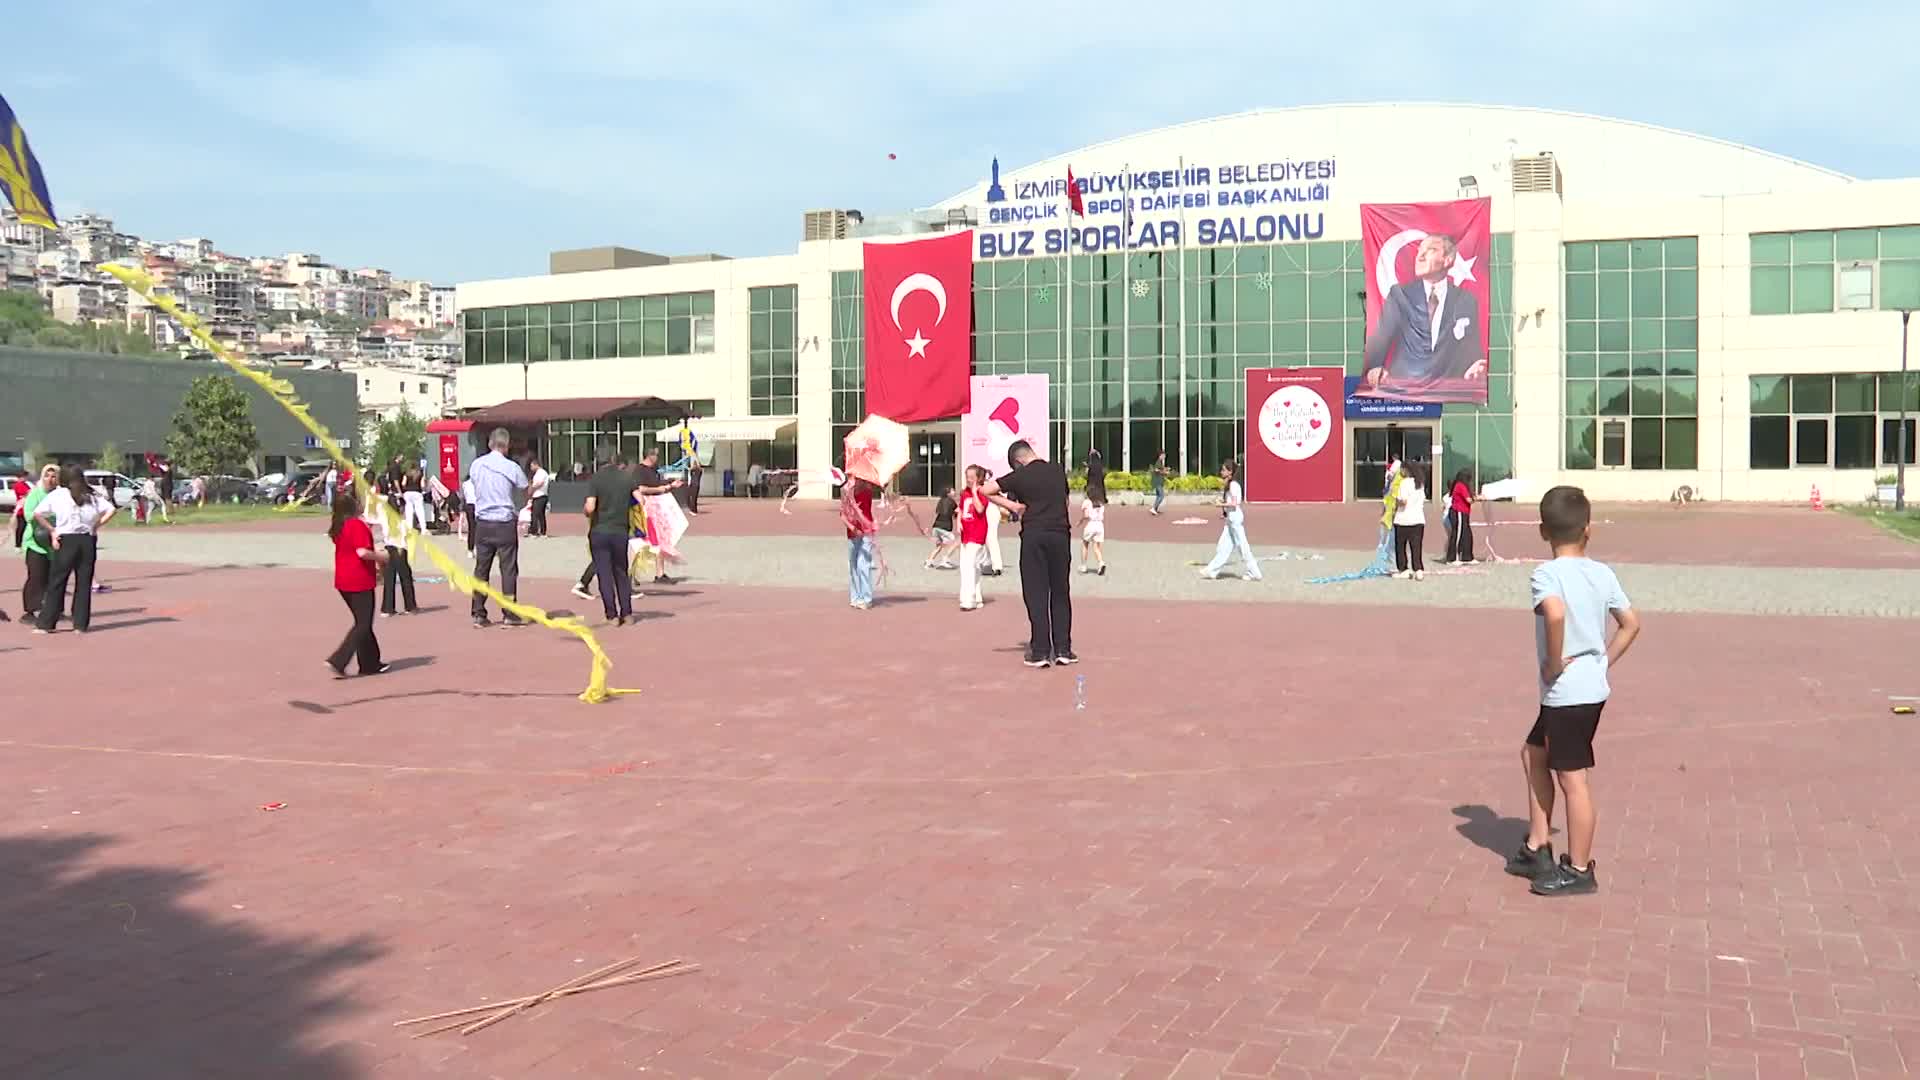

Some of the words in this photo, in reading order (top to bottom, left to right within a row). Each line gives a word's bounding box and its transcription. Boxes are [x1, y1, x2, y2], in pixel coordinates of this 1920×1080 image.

[1014, 176, 1068, 200] İZMİR
[1074, 163, 1210, 197] BÜYÜKŞEHİR
[1218, 156, 1336, 185] BELEDİYESİ
[989, 201, 1059, 225] GENÇLİK
[1217, 182, 1330, 208] BAŞKANLIĞI
[979, 229, 1035, 258] BUZ
[1044, 218, 1185, 255] SPORLAR
[1198, 213, 1324, 246] SALONU
